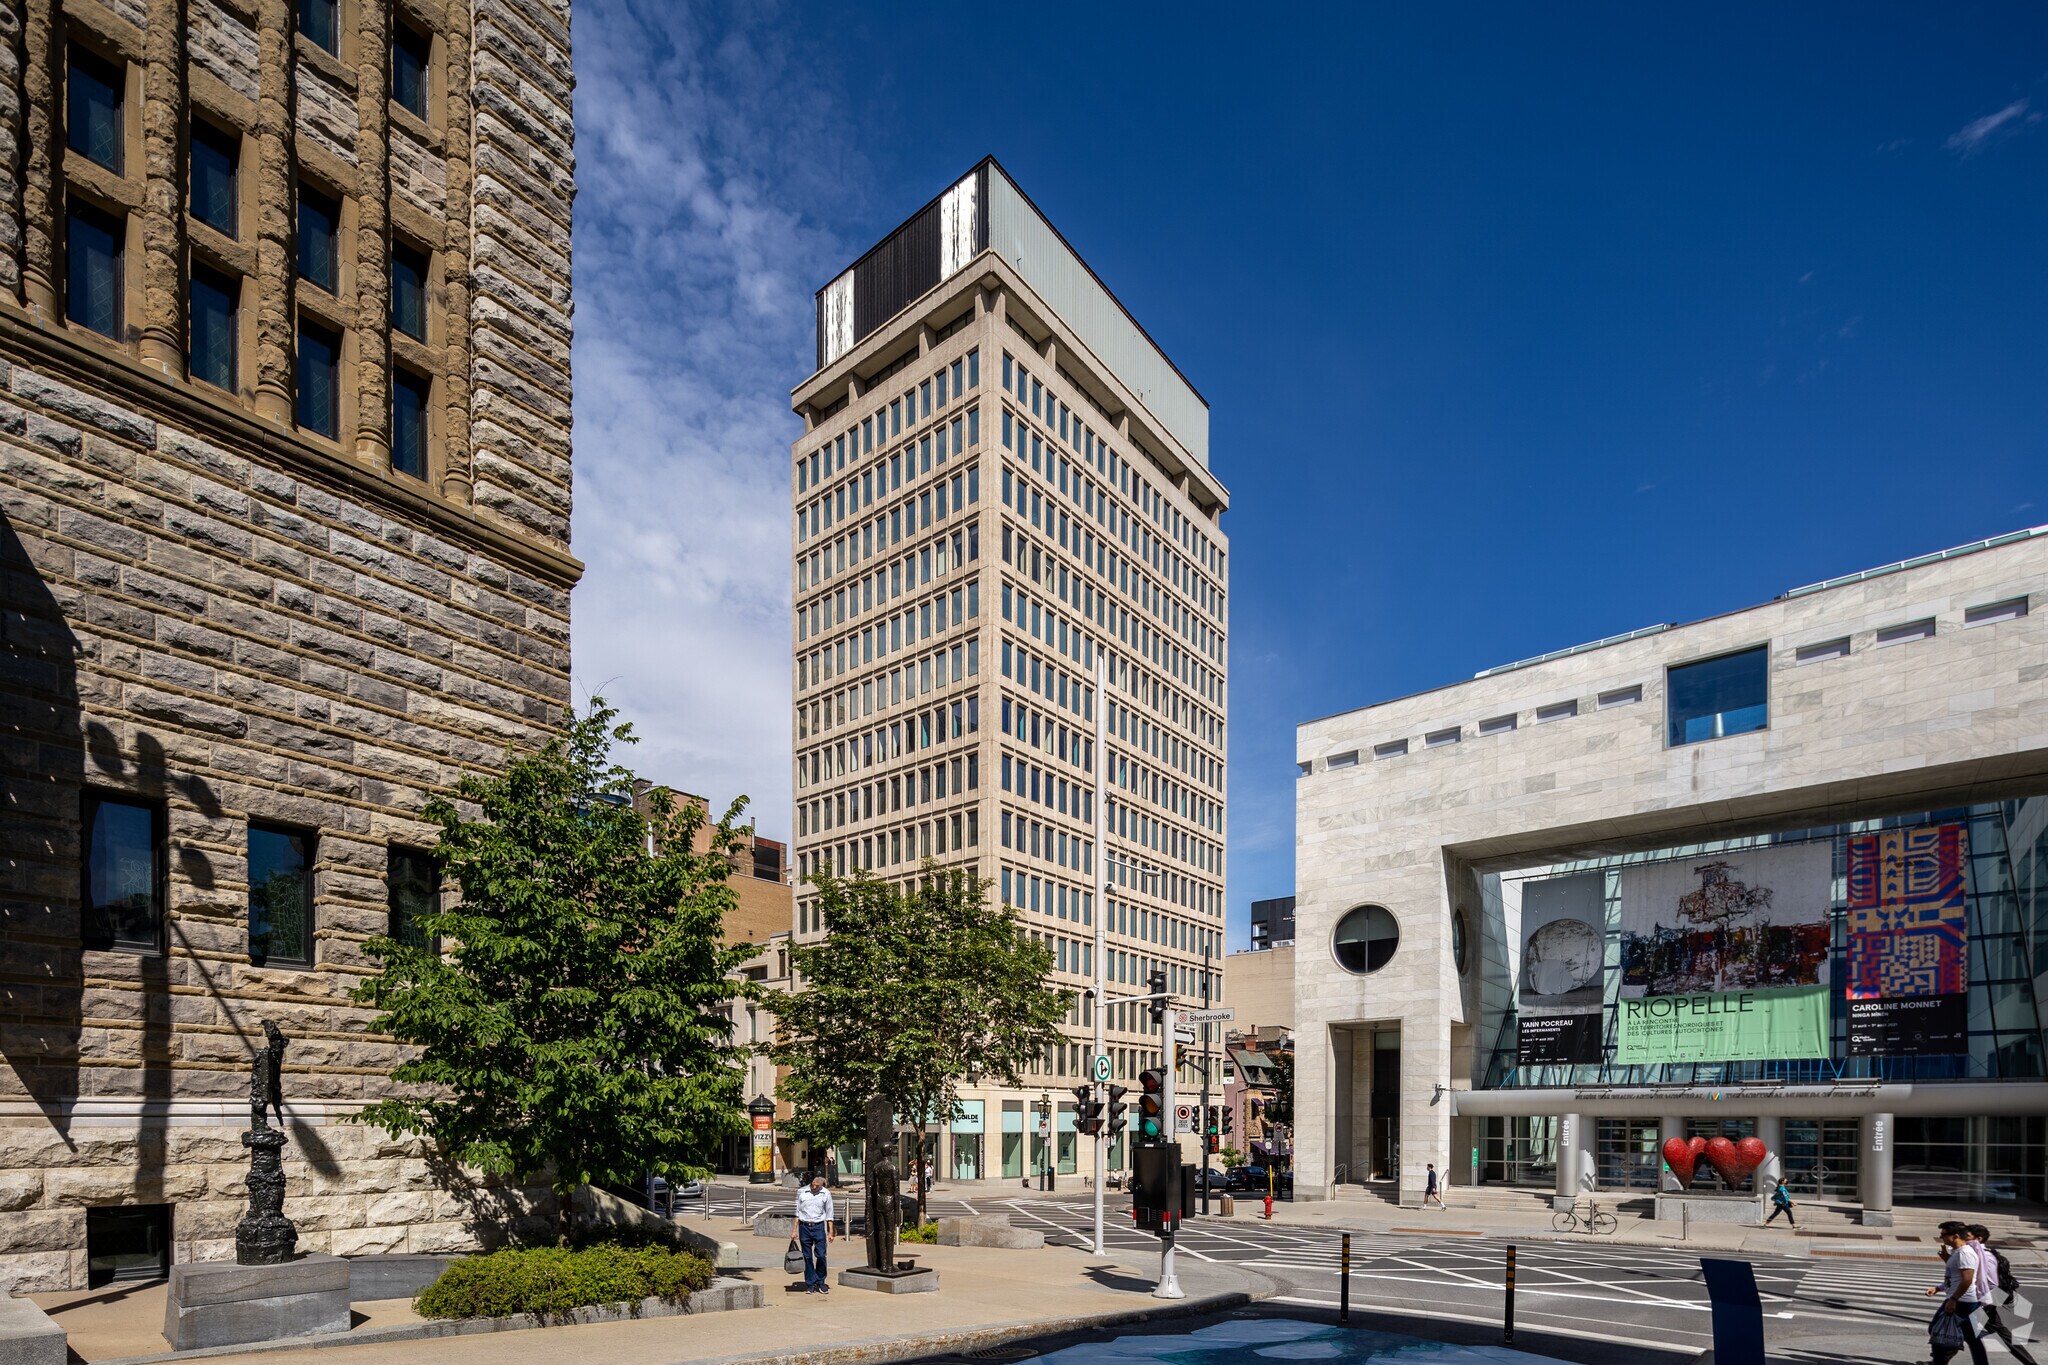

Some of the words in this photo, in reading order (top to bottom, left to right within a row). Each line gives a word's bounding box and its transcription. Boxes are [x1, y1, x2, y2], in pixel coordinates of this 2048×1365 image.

[1627, 993, 1754, 1019] RIOPELLE
[1852, 1002, 1898, 1012] CAROLINE
[1900, 1000, 1942, 1009] MONNET
[1189, 1013, 1231, 1022] Sherbrooke
[1540, 1019, 1574, 1027] POCREAU
[1561, 1119, 1570, 1147] Entrée
[1872, 1120, 1884, 1152] Entrée
